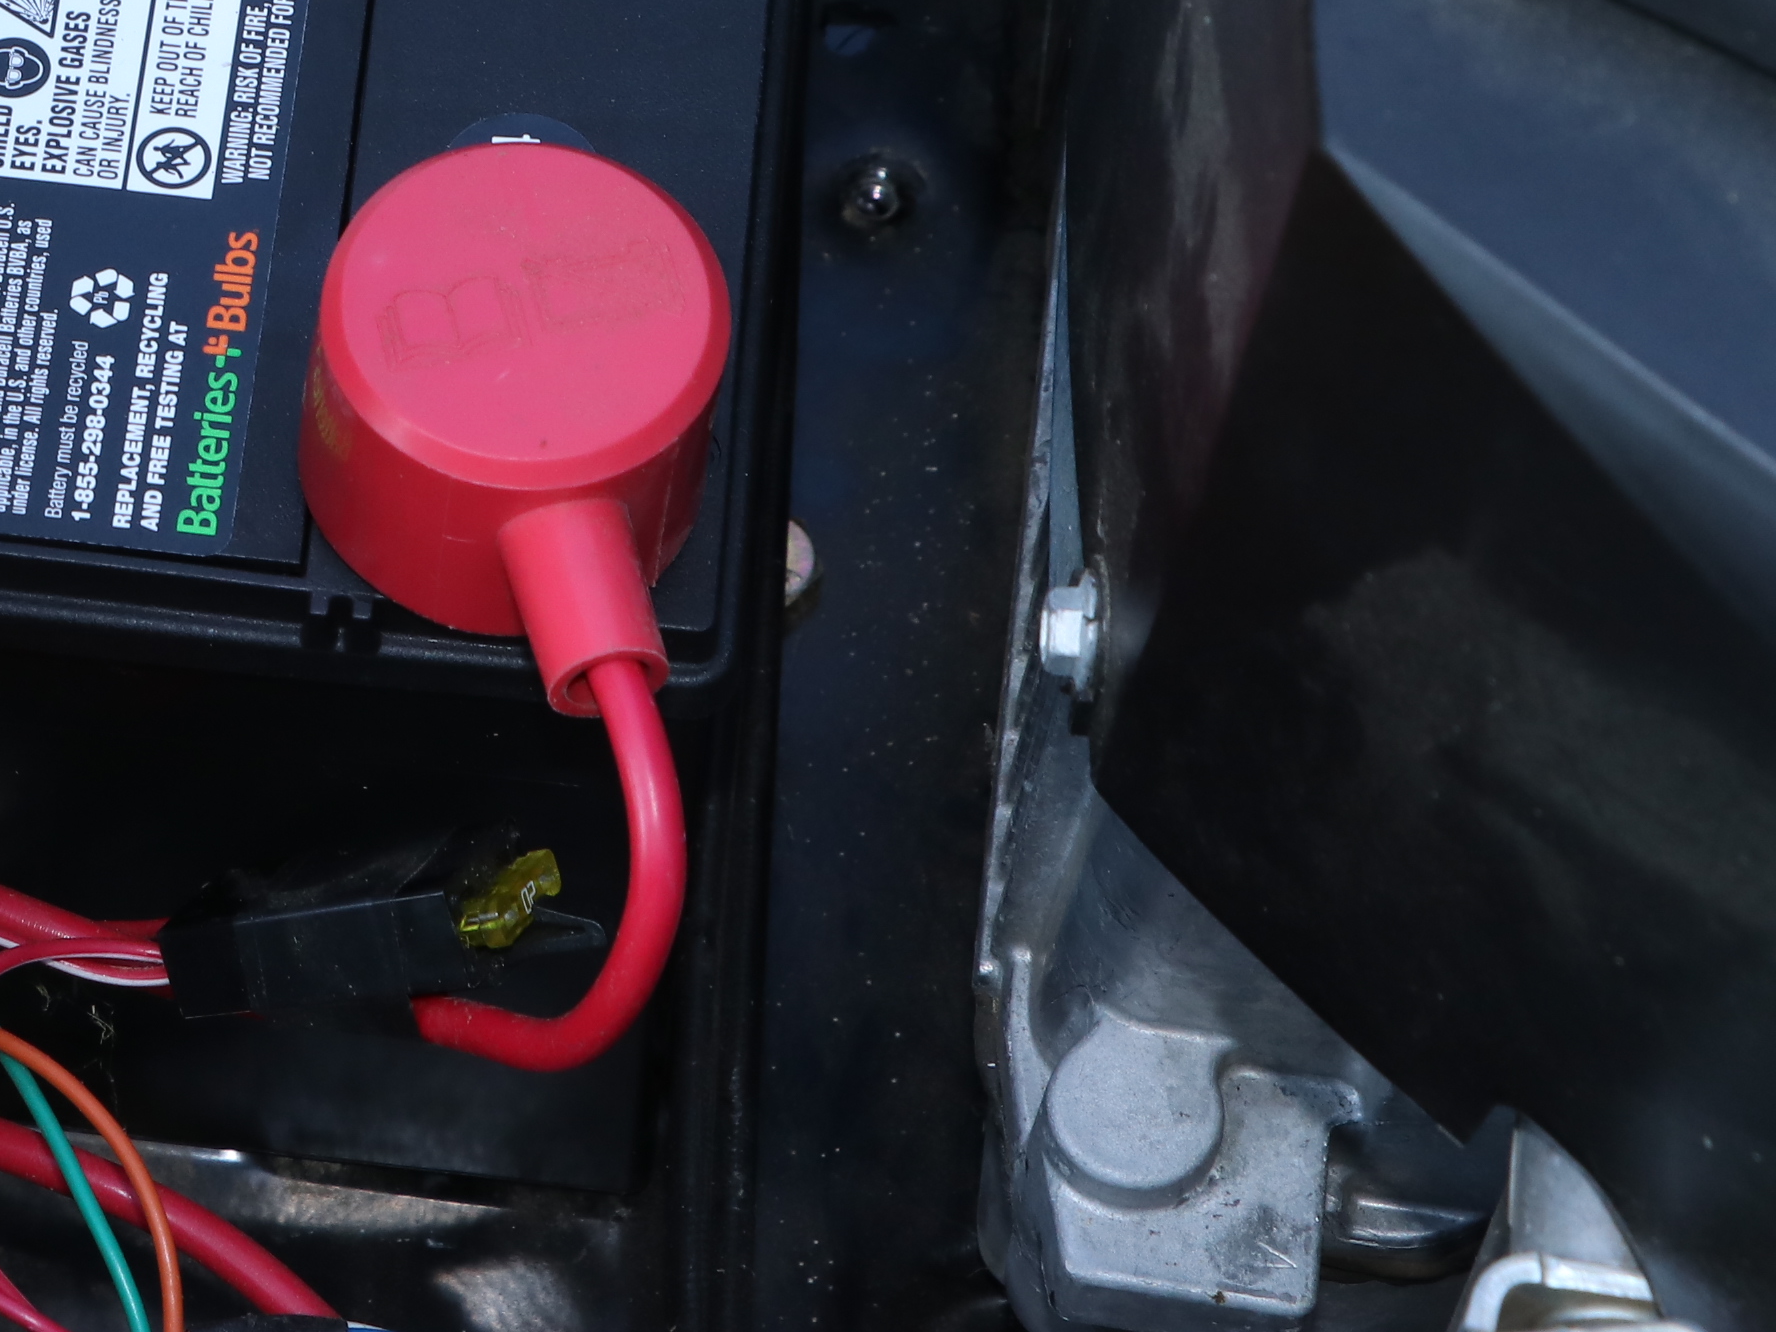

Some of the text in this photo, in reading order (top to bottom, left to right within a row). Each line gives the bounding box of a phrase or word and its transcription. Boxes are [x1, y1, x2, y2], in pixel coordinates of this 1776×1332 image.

[161, 16, 184, 36] OF
[242, 2, 273, 41] FIRE,
[156, 40, 181, 72] OUT
[183, 41, 206, 61] OF
[238, 42, 262, 64] OF
[41, 11, 91, 175] EXPLOSIVE GASES
[150, 77, 175, 115] KEEP
[174, 66, 203, 118] REACH
[233, 66, 260, 103] RISK
[252, 28, 291, 145] RECOMMENDED
[78, 89, 106, 141] CAUSE
[96, 94, 130, 180] OR INJURY.
[10, 120, 43, 172] EYES.
[73, 146, 97, 177] CAN
[220, 106, 254, 184] WARNING:
[247, 147, 273, 180] NOT
[92, 291, 109, 304] Pb
[112, 273, 169, 529] REPLACEMENT, RECYCLING
[140, 320, 188, 532] AND FREE TESTING AT
[44, 340, 89, 519] Battery must be recycled
[71, 355, 115, 522] 1-855-298-0344
